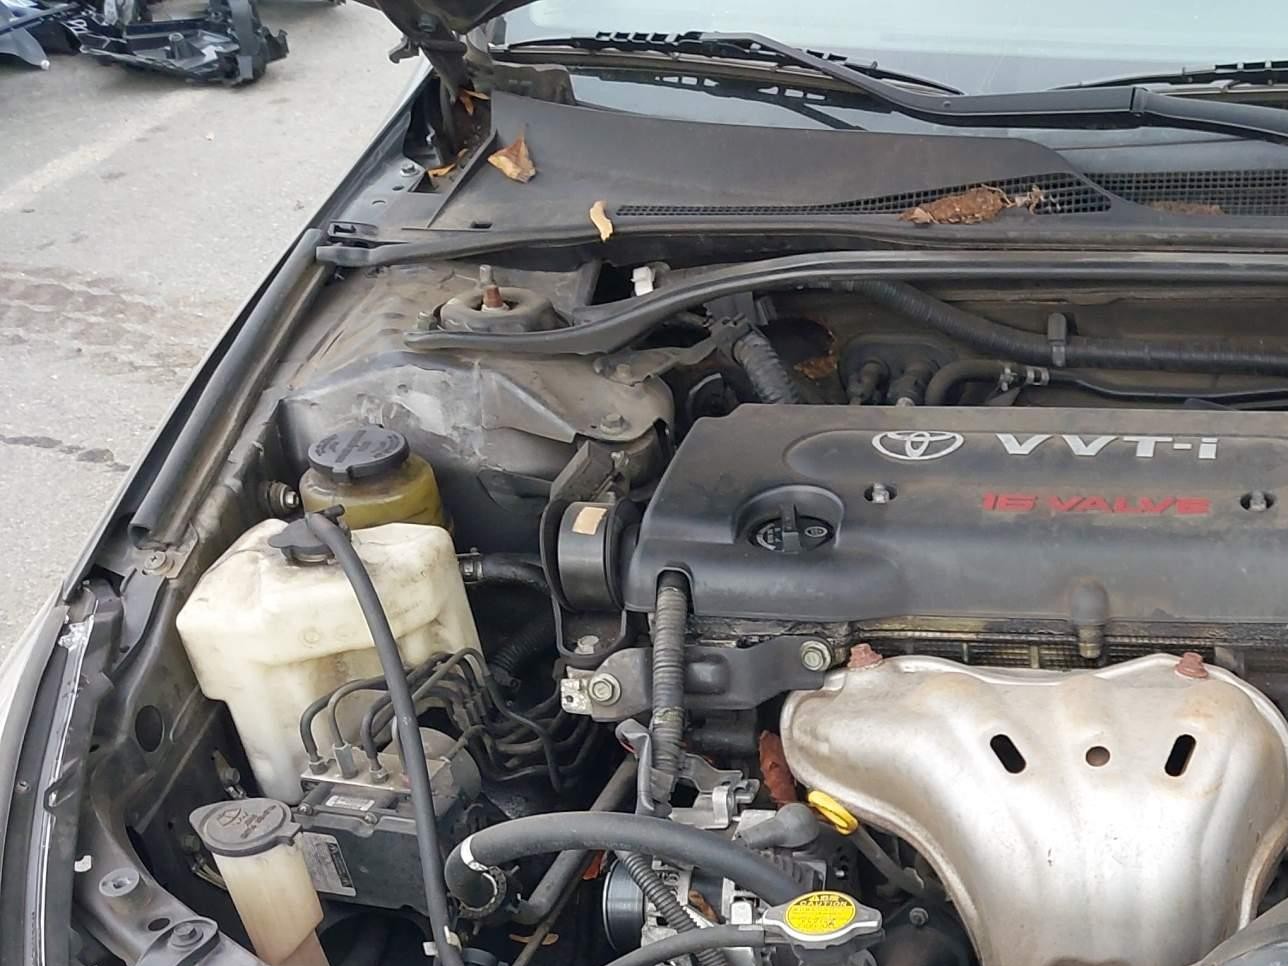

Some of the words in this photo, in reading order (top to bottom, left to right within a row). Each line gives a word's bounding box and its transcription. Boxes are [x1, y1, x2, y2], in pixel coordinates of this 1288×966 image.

[996, 433, 1218, 460] VVT-i
[982, 493, 1038, 511] 16
[1050, 496, 1212, 514] VALVE
